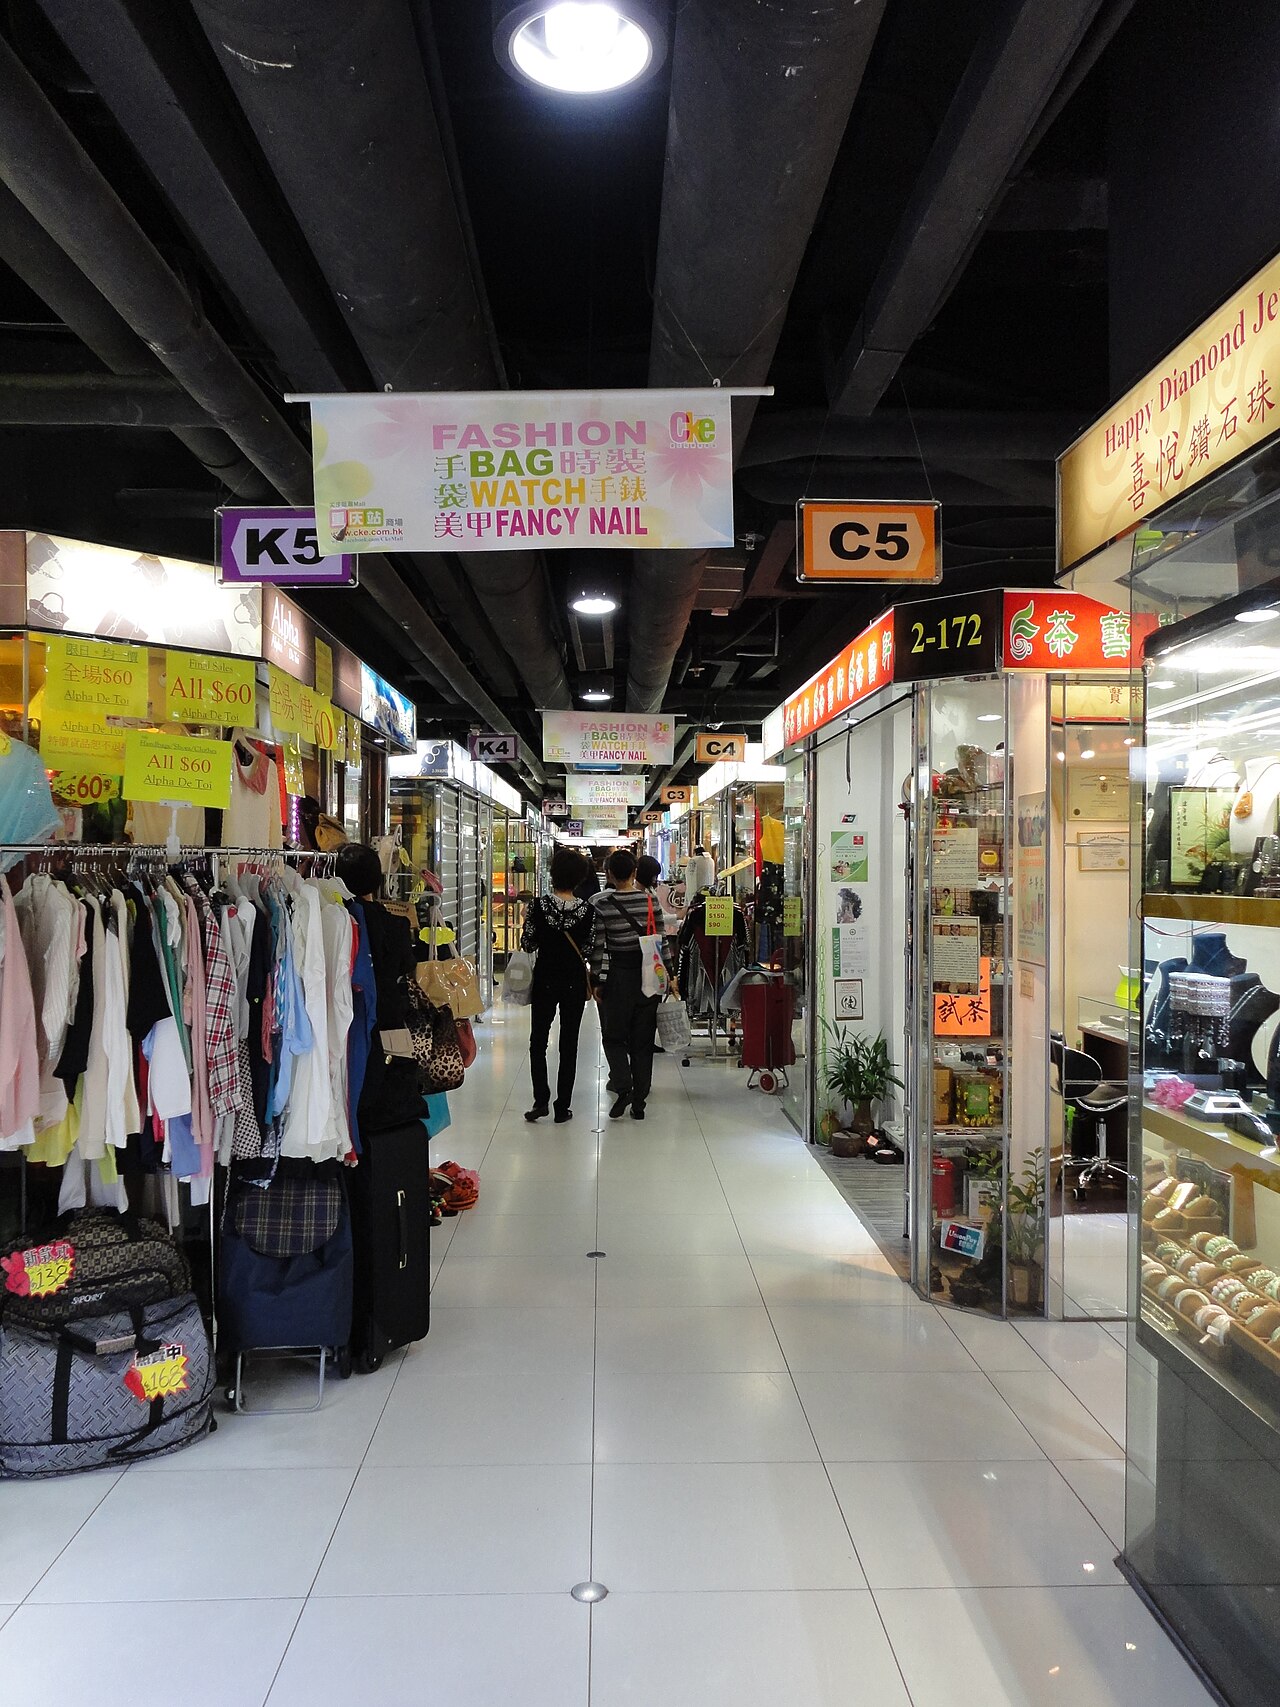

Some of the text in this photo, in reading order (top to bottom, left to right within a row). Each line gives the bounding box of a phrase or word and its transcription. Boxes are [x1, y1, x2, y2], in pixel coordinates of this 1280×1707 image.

[1105, 287, 1280, 457] Happy Diamond Je
[432, 420, 647, 450] FASHION
[669, 411, 716, 443] Cke
[469, 448, 554, 478] BAG
[559, 448, 647, 475] 時裝
[470, 477, 586, 508] WATCH
[590, 475, 648, 503] 手錶
[434, 511, 492, 539] 美甲
[496, 506, 649, 537] FANCY NAIL
[331, 528, 403, 537] w.cke.com.hk
[829, 521, 910, 561] C5
[246, 528, 326, 565] K5
[271, 595, 300, 649] Alpha
[911, 613, 983, 654] 2-172
[189, 658, 234, 672] Final Sales
[64, 690, 93, 702] Alpha
[97, 693, 111, 703] De
[170, 677, 252, 705] All $60
[181, 708, 239, 721] Alpha De Toi
[61, 720, 90, 733] Alpha
[581, 723, 648, 732] FASHION
[592, 732, 618, 741] BAG
[478, 740, 509, 756] K4
[592, 741, 628, 750] WATCH
[706, 741, 736, 756] C4
[147, 754, 211, 774] All $60
[599, 751, 647, 761] FANCY NAIL
[144, 774, 212, 789] Alpha De Toi
[666, 790, 685, 800] C3
[548, 804, 563, 812] K3
[645, 813, 659, 821] C2
[833, 936, 841, 972] ORGANIC
[937, 999, 989, 1026] 試茶
[71, 1292, 106, 1305] SPORT
